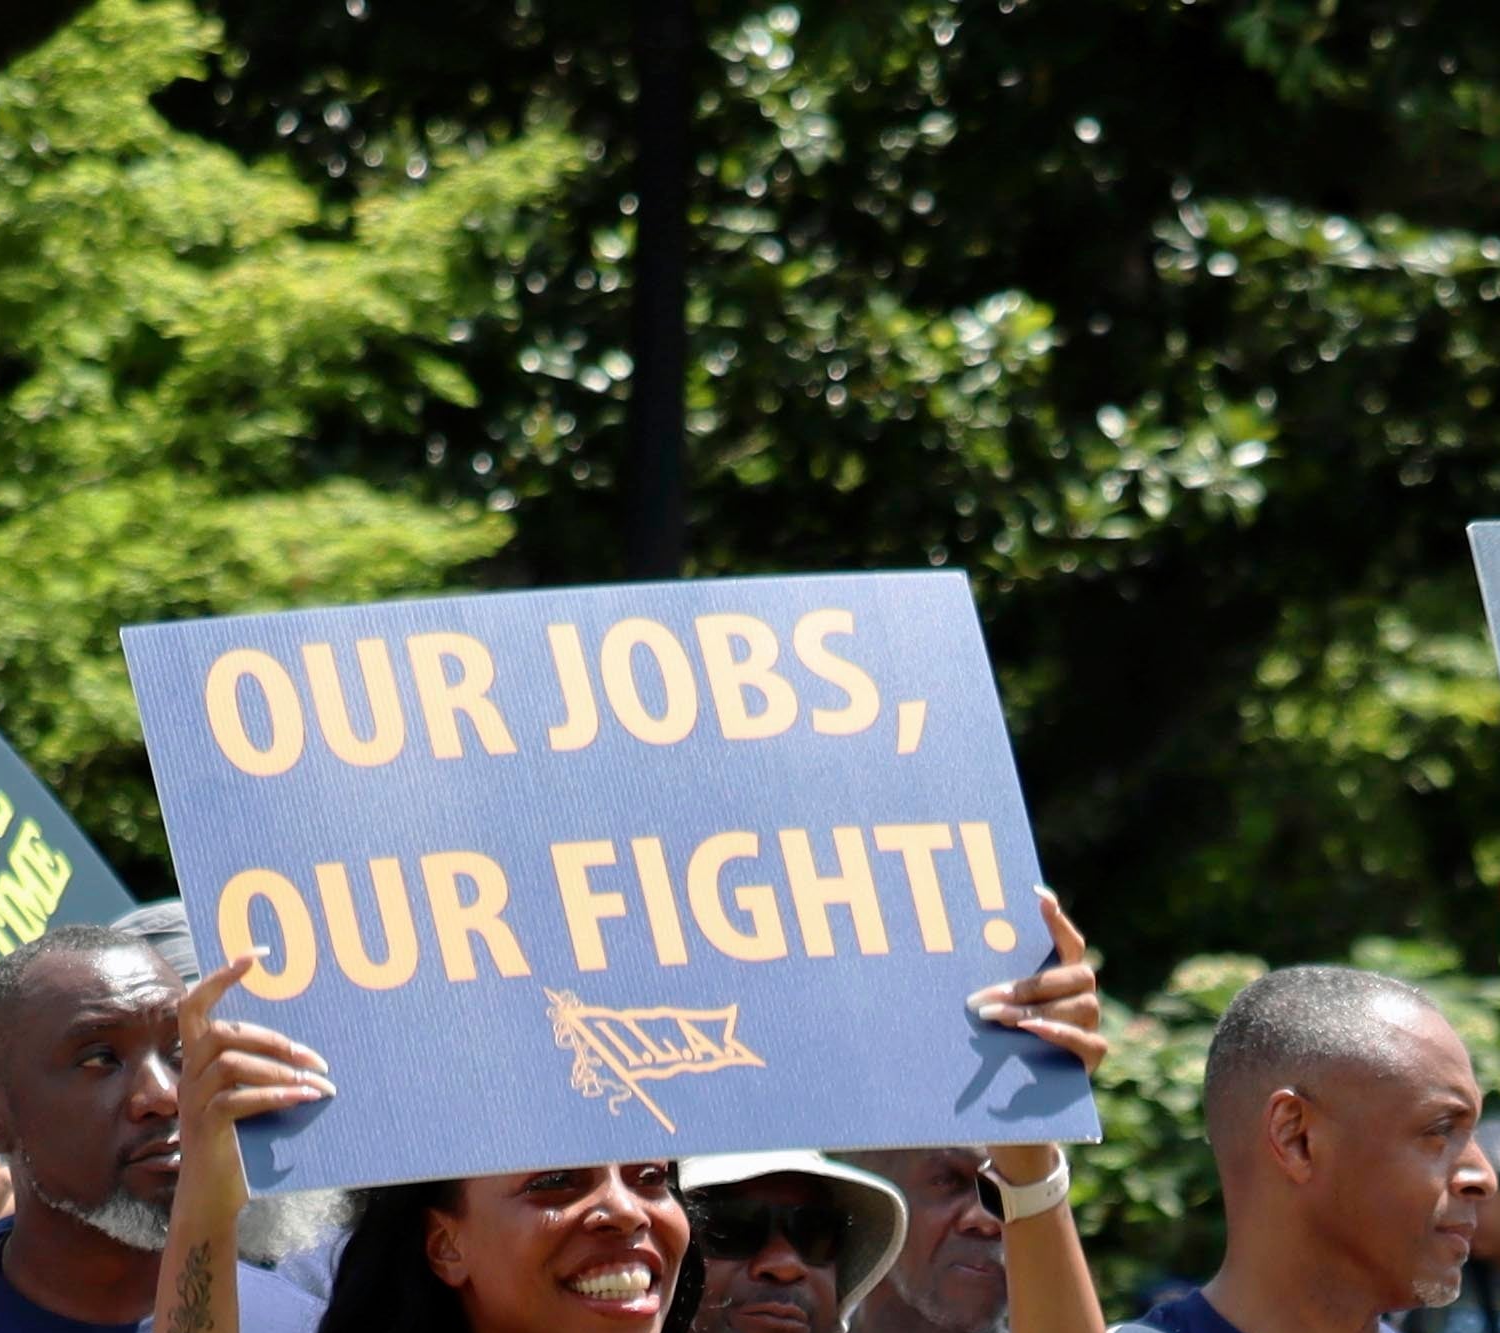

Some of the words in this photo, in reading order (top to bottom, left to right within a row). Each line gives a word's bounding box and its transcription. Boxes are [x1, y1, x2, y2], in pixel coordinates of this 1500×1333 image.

[203, 630, 518, 779] OUR
[545, 607, 930, 756] JOBS,
[216, 850, 532, 1001] OUR
[550, 821, 1019, 973] FIGHT!
